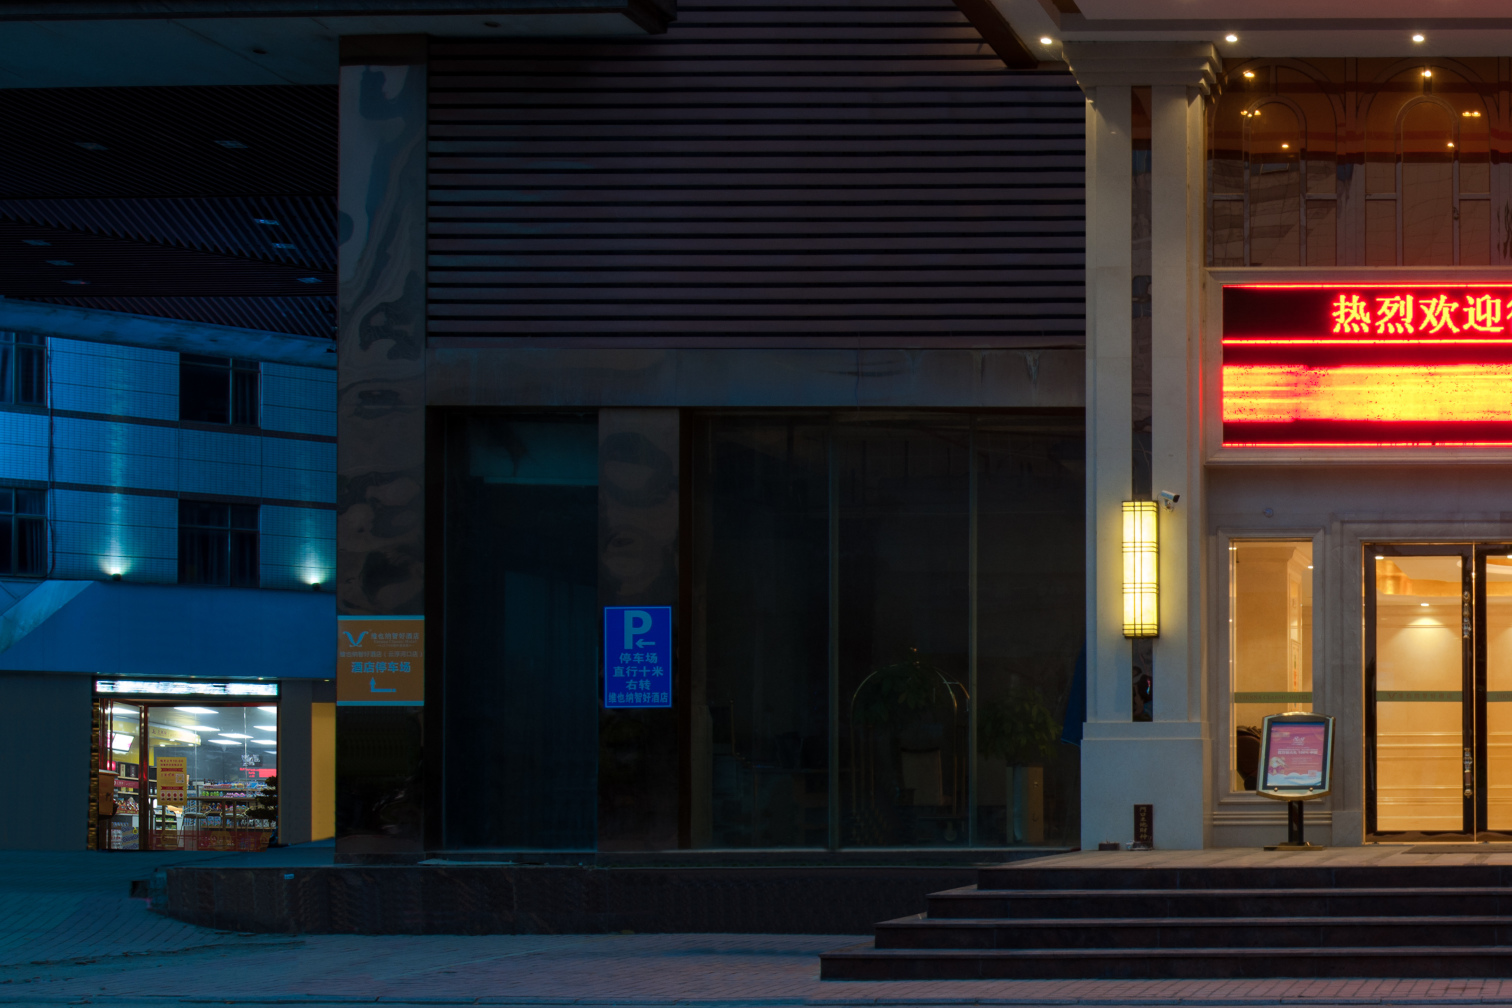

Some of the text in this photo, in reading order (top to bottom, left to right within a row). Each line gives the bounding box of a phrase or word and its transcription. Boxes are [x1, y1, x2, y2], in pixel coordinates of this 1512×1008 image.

[623, 610, 653, 650] P
[619, 652, 658, 664] 停车场
[351, 661, 411, 673] 酒店停车场
[612, 665, 664, 677] 直行十米
[625, 679, 651, 691] 右转
[608, 692, 669, 704] 维也纳智好酒店
